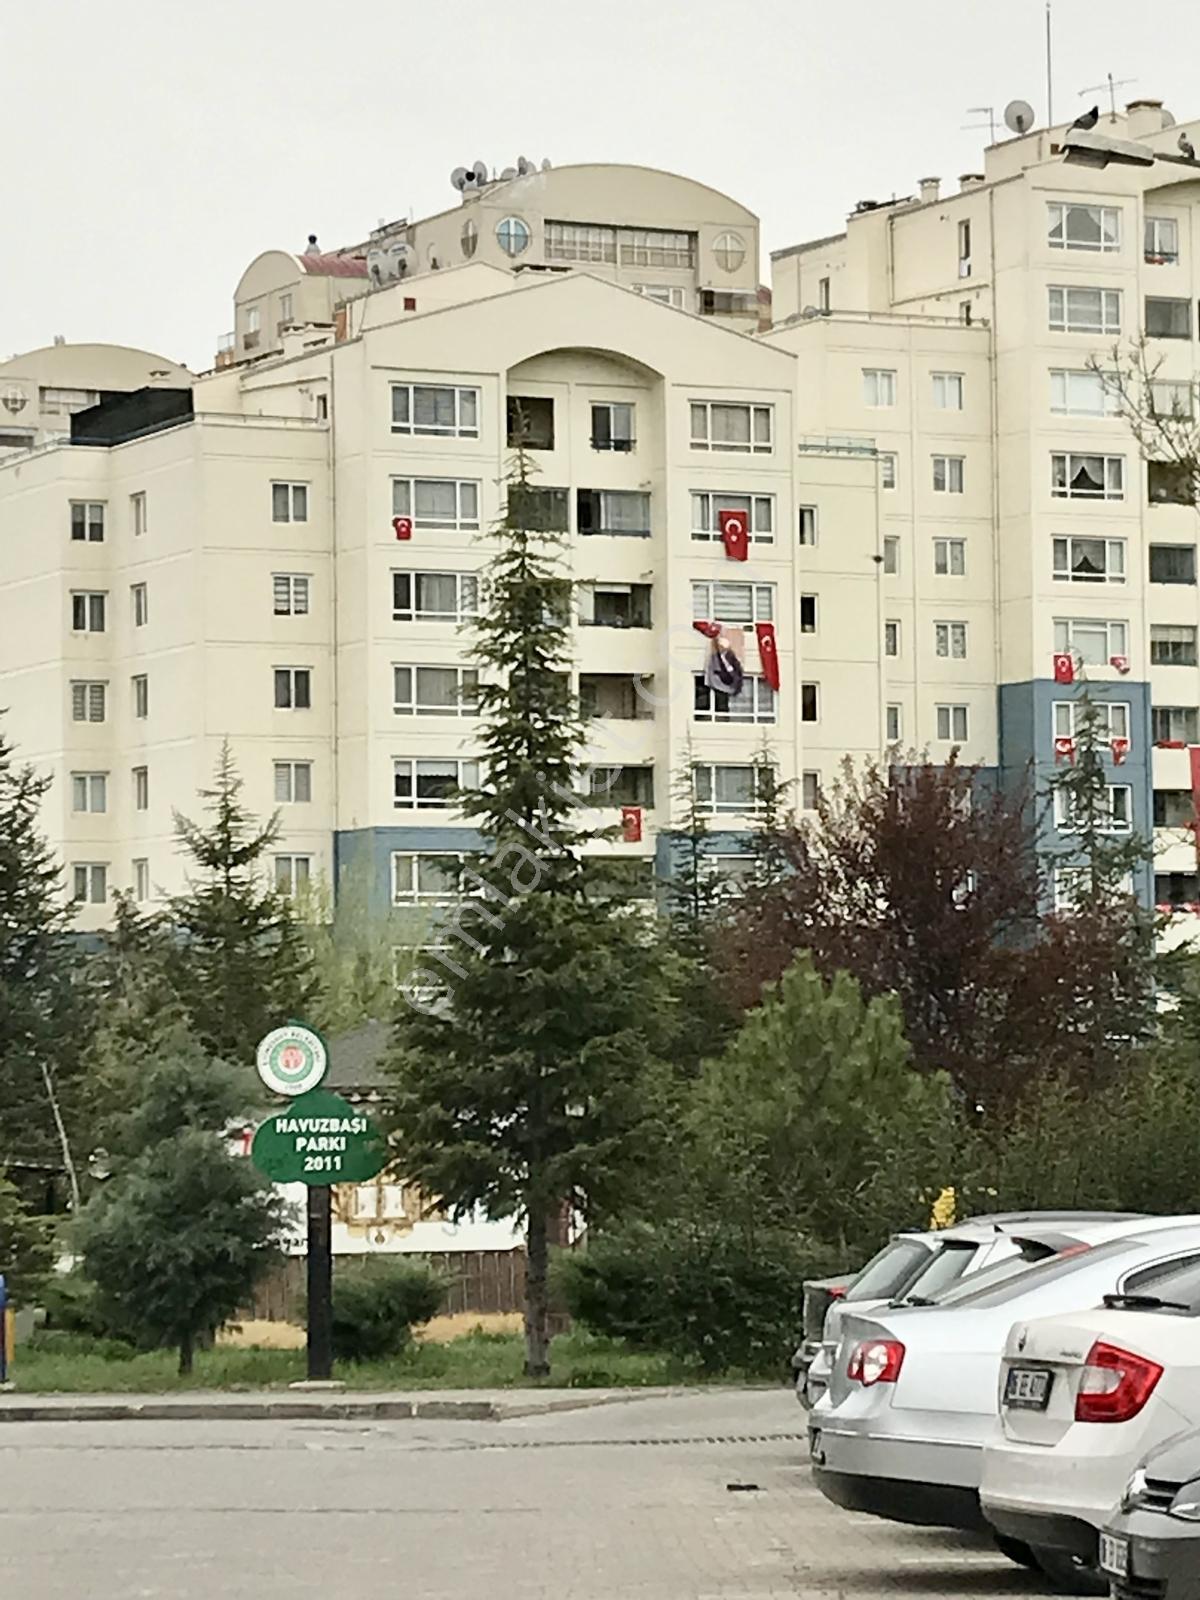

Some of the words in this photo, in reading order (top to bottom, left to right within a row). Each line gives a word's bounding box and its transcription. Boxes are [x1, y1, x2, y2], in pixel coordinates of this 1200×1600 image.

[275, 1117, 367, 1135] HAVUZBAŞI
[295, 1136, 346, 1152] PARKI
[303, 1155, 342, 1171] 2011
